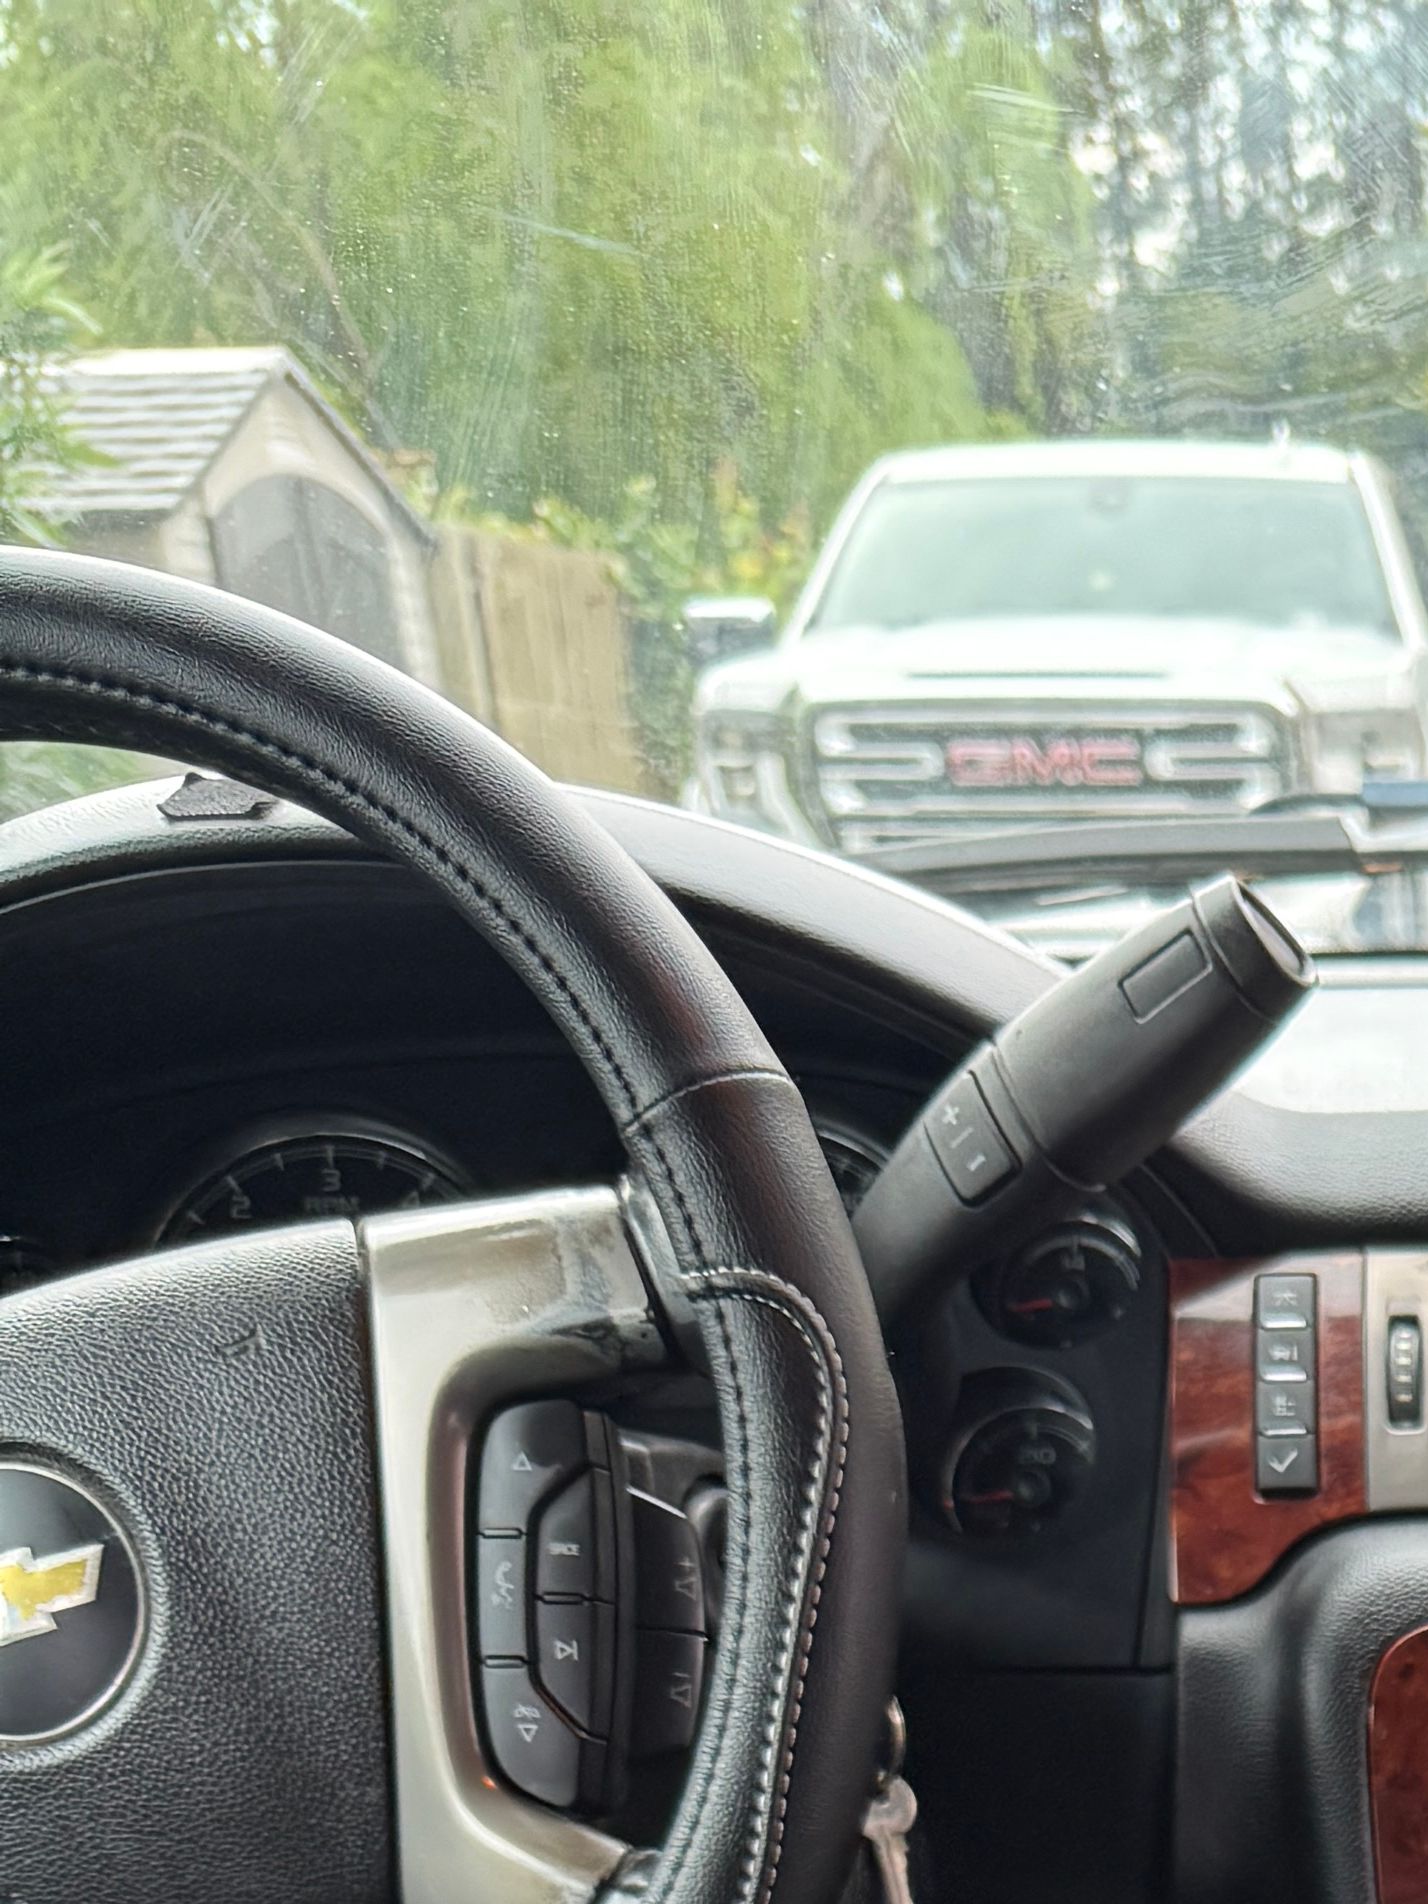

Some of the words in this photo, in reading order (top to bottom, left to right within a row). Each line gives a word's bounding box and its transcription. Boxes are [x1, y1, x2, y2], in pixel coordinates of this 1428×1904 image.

[946, 738, 1142, 787] GMC
[322, 1168, 342, 1192] 3
[230, 1196, 252, 1219] 2
